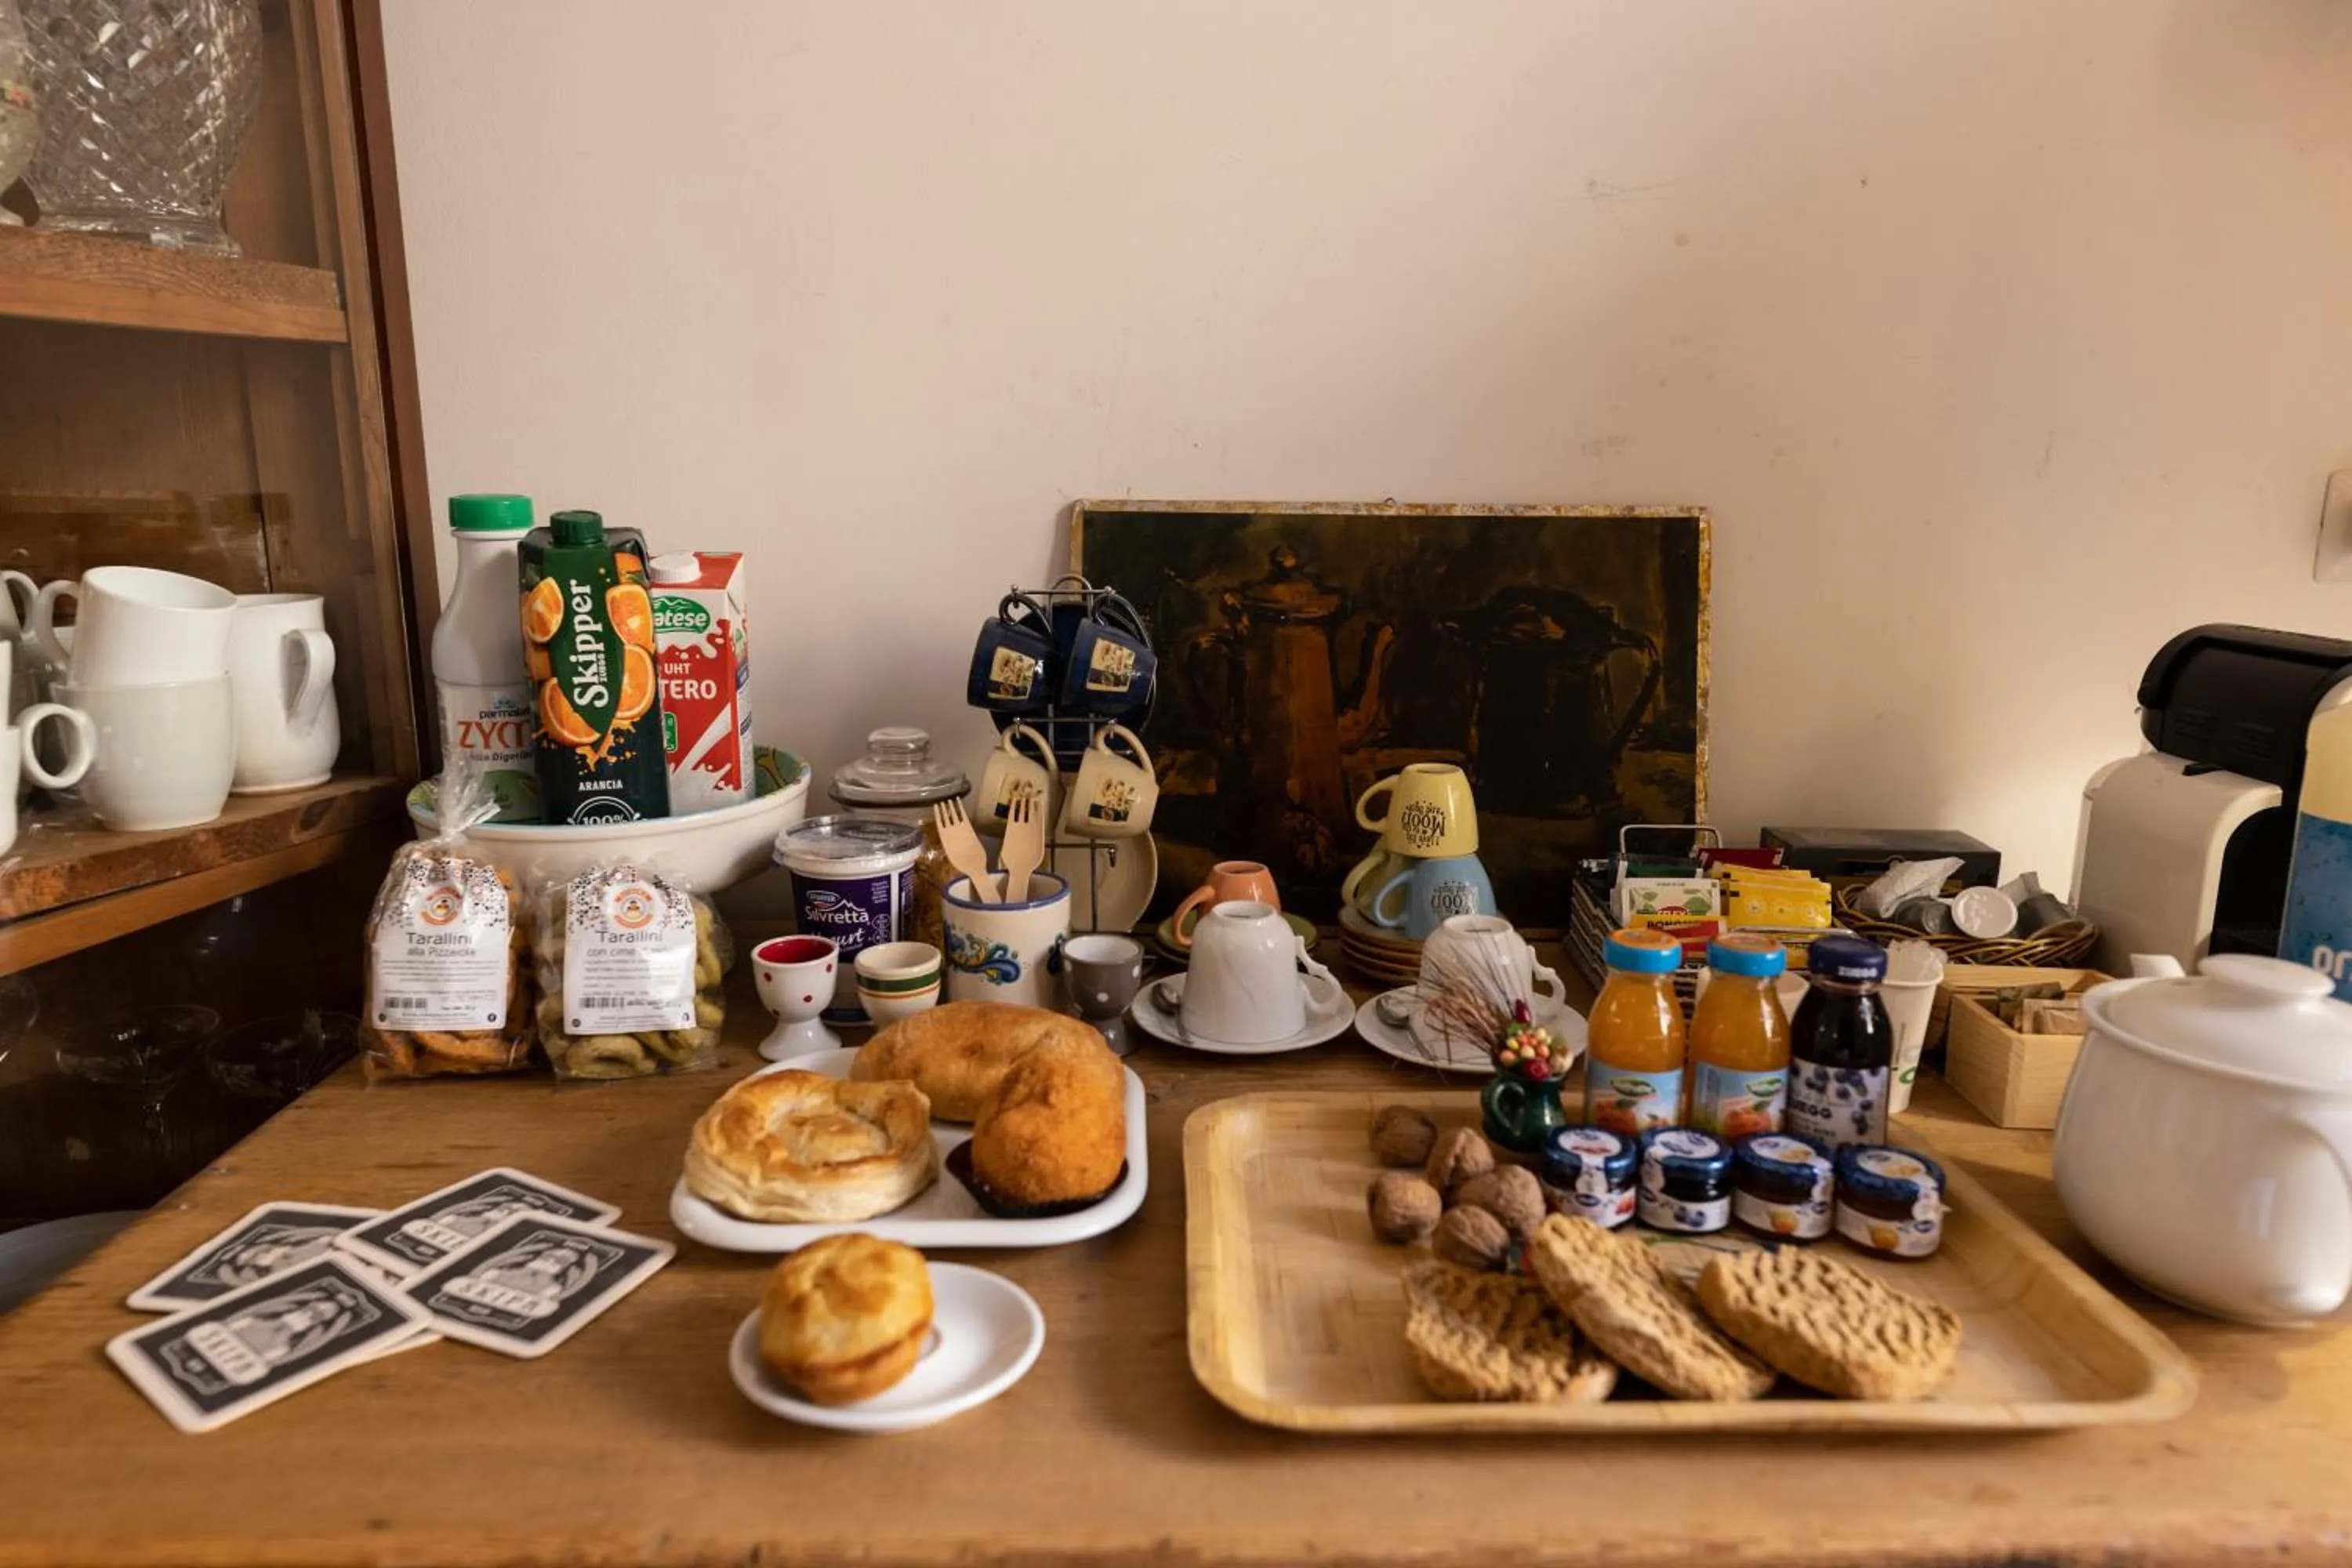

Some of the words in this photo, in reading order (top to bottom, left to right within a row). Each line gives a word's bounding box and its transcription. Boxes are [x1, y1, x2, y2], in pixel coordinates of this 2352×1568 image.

[653, 611, 707, 627] atese
[569, 579, 609, 708] Skipper
[664, 662, 691, 675] UHT
[659, 680, 717, 699] TERO
[578, 779, 624, 791] ARANCIA
[805, 905, 869, 924] Silvretta
[406, 932, 472, 945] Tarallini
[595, 931, 663, 943] Tarallini
